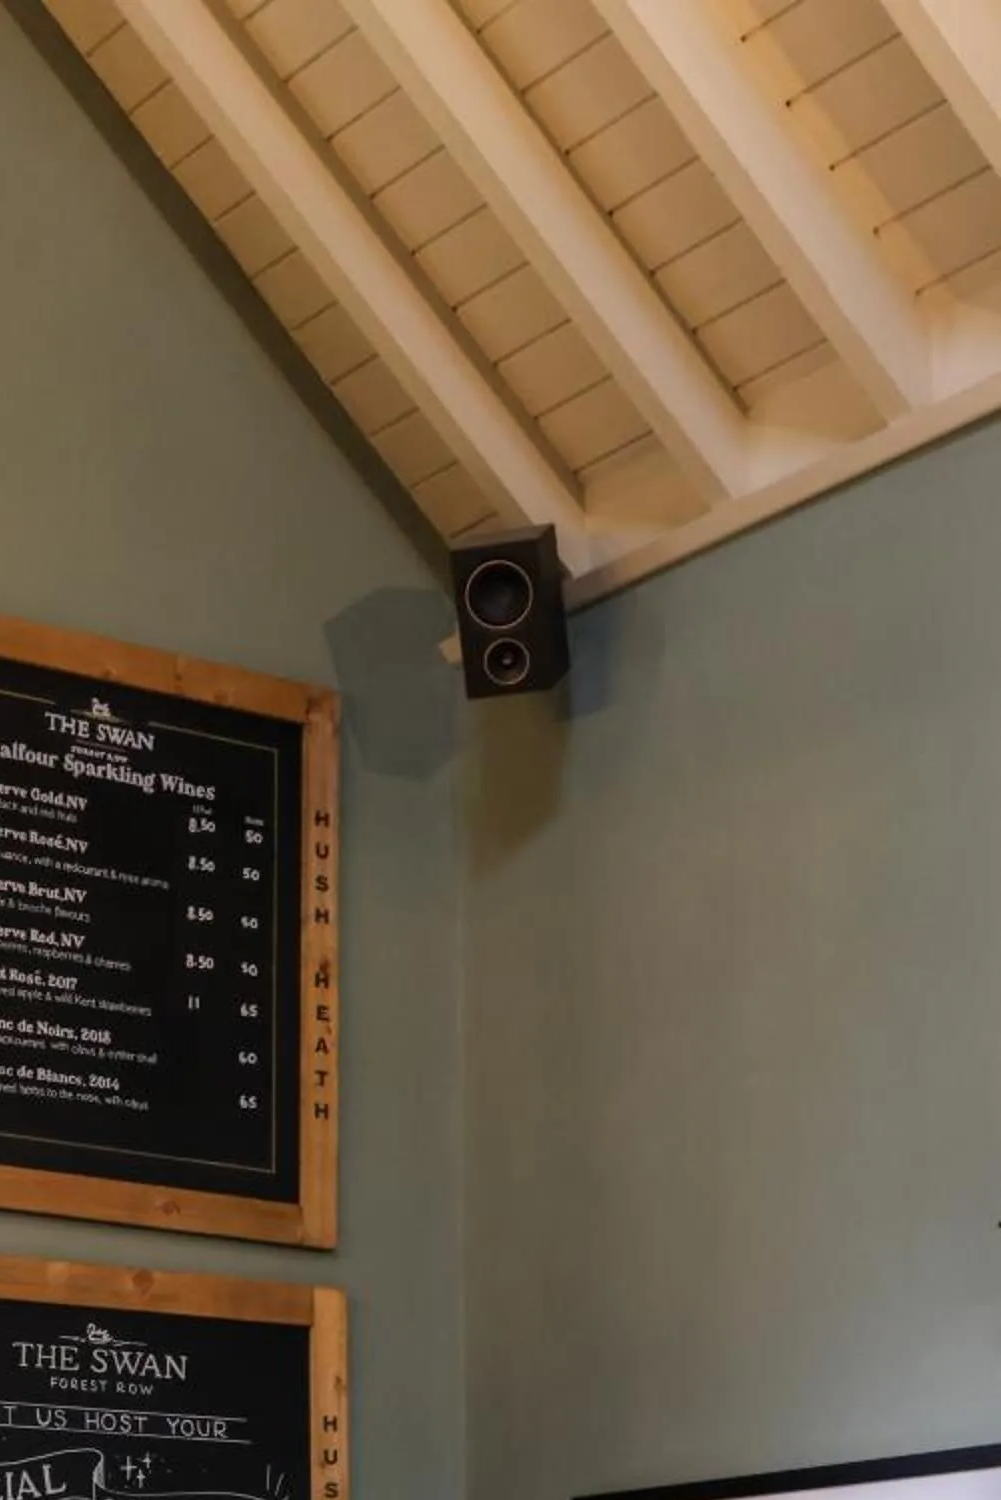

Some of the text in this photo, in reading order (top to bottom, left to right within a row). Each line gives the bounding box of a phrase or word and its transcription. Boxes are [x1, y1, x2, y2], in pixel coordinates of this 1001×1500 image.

[44, 712, 155, 751] THE SWAN
[64, 752, 156, 794] Sparkling
[160, 773, 216, 801] Wines
[242, 867, 260, 881] 50
[60, 931, 86, 949] NV
[314, 810, 330, 1121] HUSH HEATH
[48, 974, 78, 990] 2017
[240, 1002, 259, 1017] 65
[17, 1019, 34, 1033] de
[16, 1065, 33, 1079] de
[88, 1074, 120, 1091] 2014
[12, 1341, 188, 1381] THE SWAN
[50, 1376, 154, 1396] FOREST ROW
[36, 1407, 67, 1428] US
[84, 1411, 148, 1434] HOST
[166, 1416, 228, 1439] YOUR
